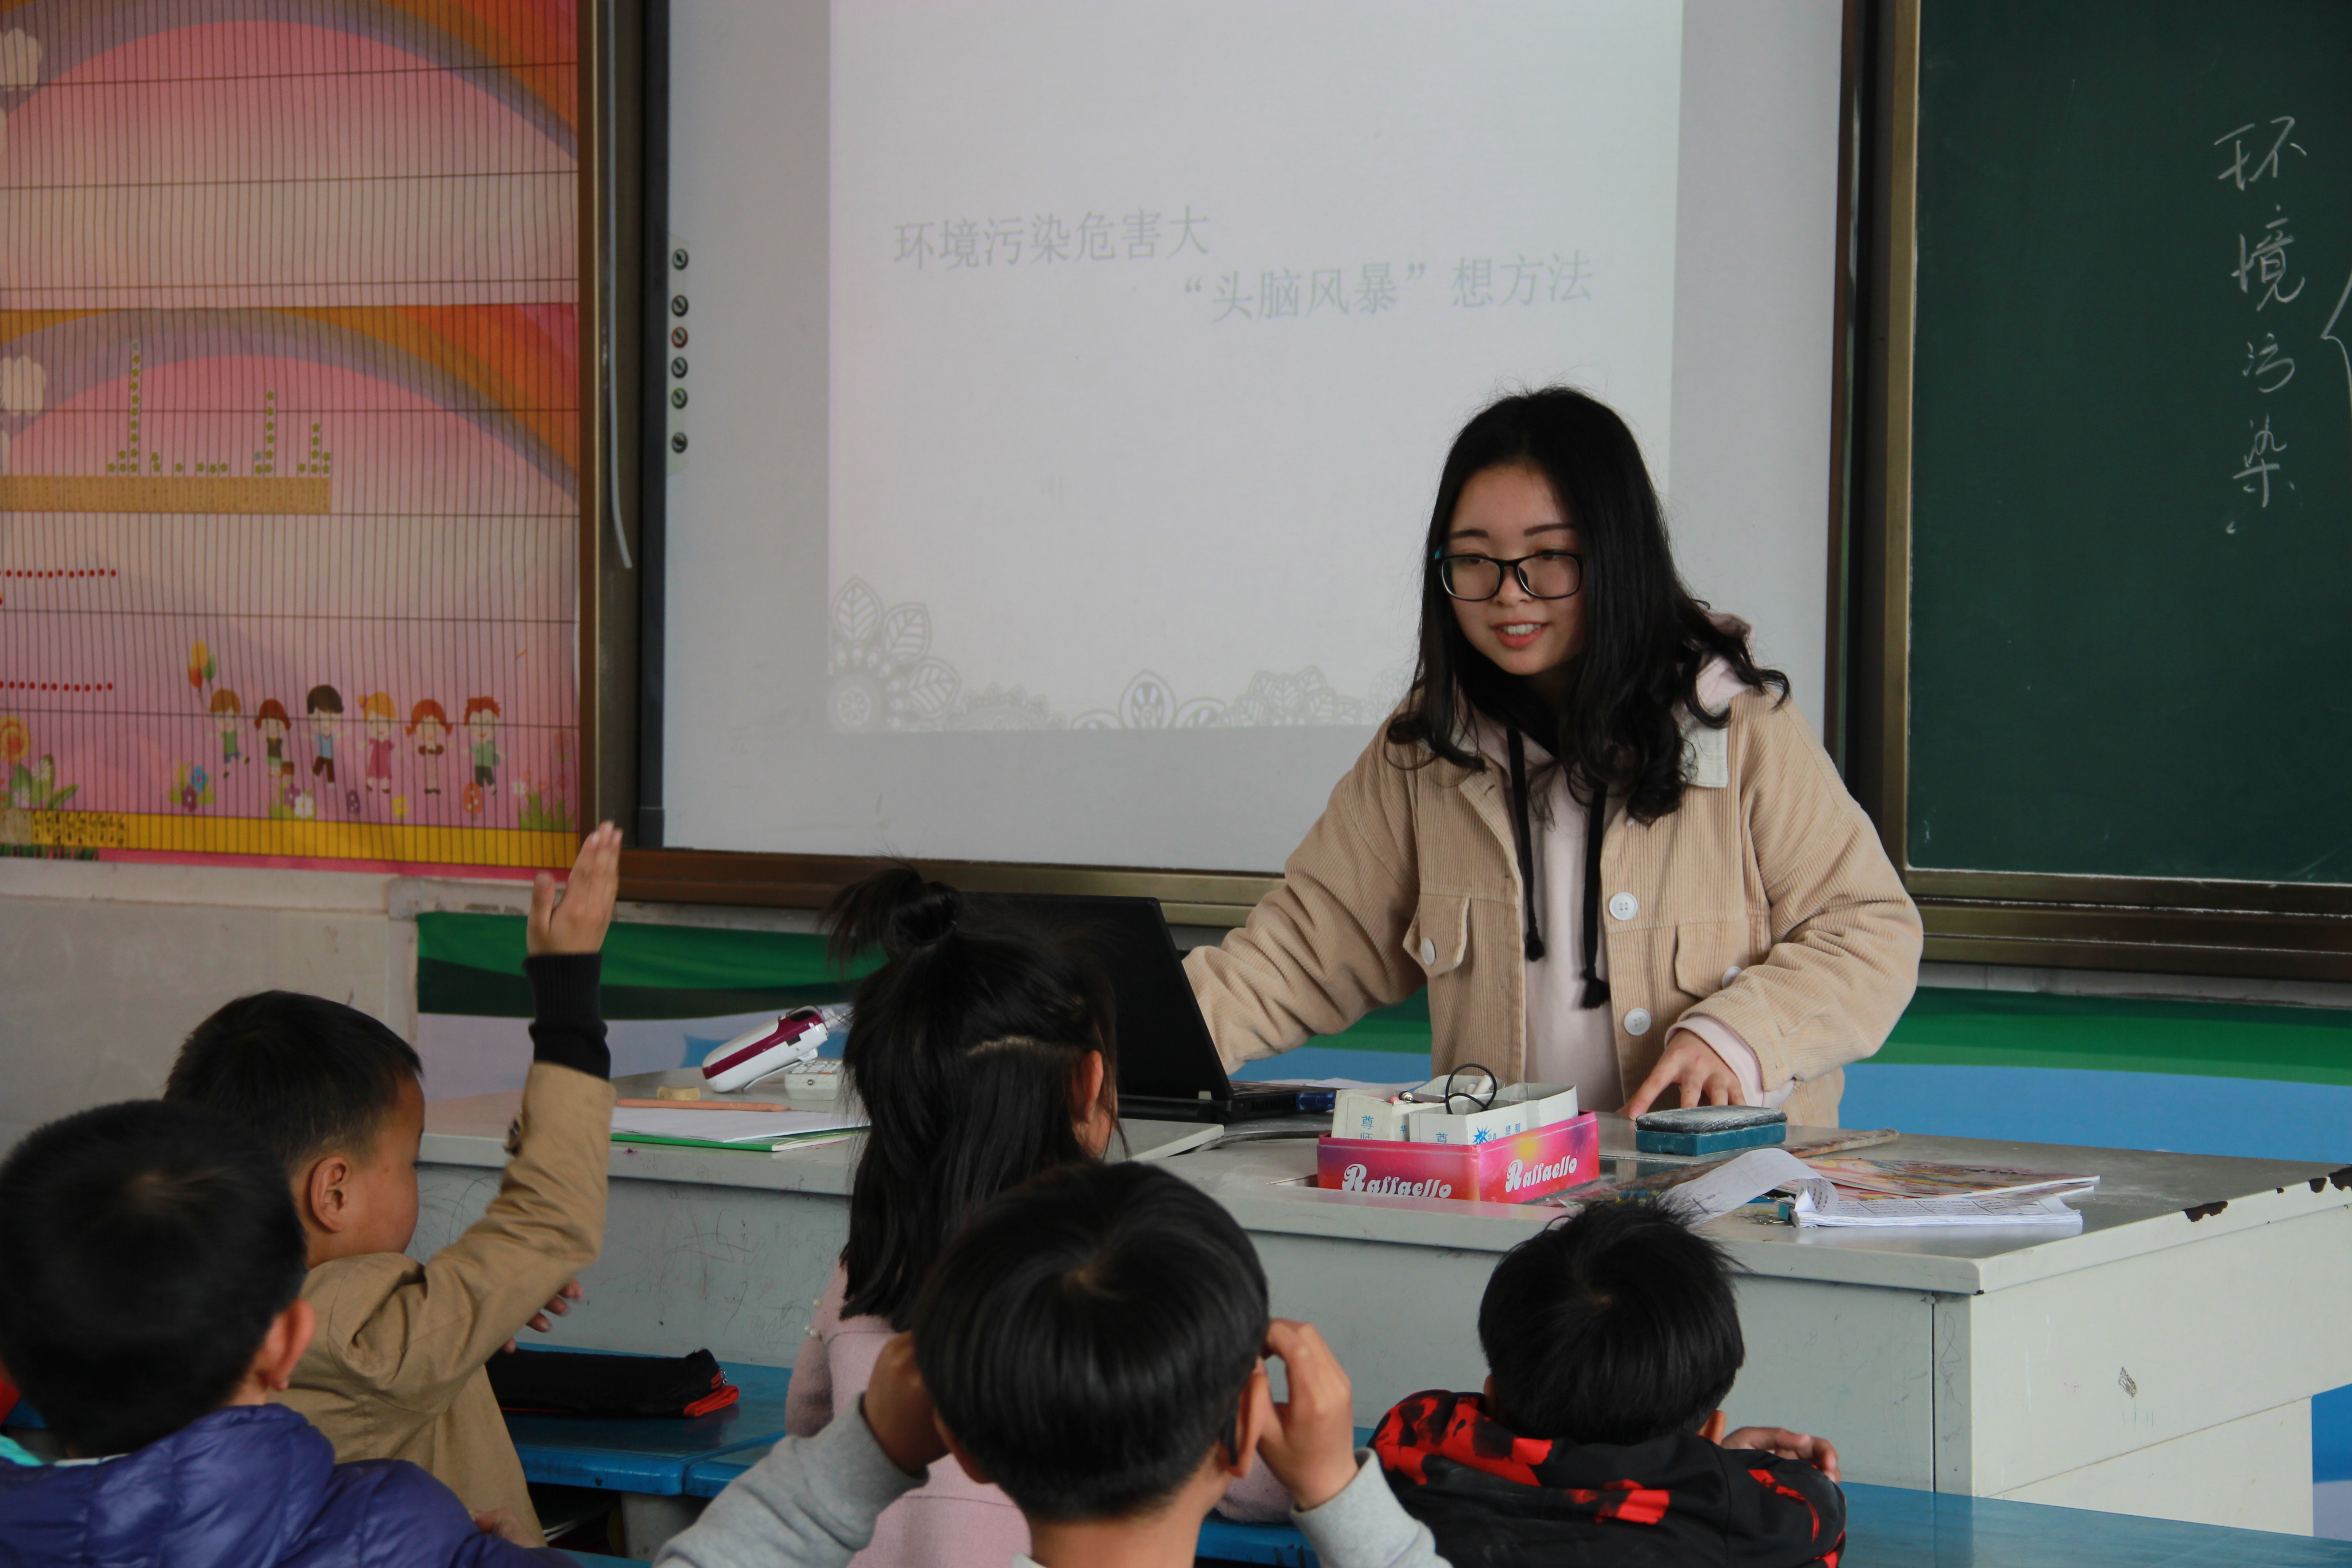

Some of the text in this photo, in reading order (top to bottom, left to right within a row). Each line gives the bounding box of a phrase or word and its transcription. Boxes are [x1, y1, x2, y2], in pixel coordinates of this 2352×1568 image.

[893, 206, 1210, 270] 环境污染危害大
[2213, 116, 2307, 509] 环境污染
[1342, 1163, 1452, 1199] Raffaello
[1505, 1155, 1578, 1193] Raffaello
